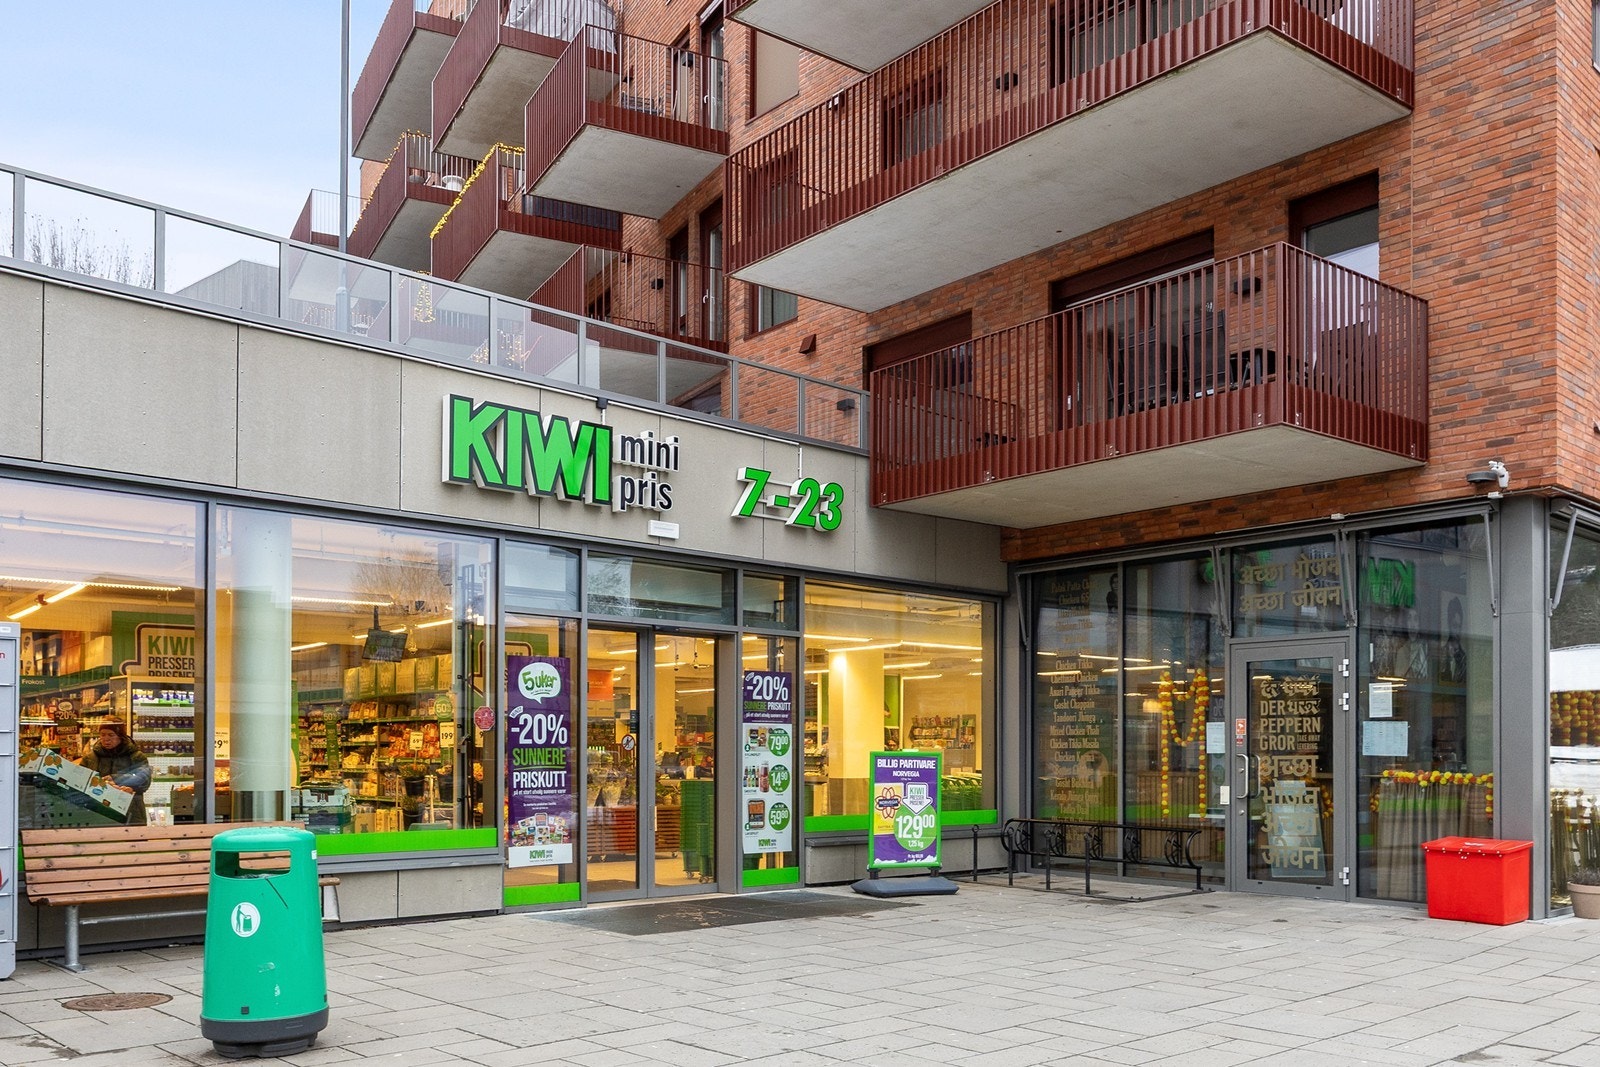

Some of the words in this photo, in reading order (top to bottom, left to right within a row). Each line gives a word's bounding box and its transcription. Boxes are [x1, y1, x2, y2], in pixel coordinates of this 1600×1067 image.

[445, 394, 613, 505] KIWI
[619, 430, 679, 472] mini
[619, 471, 673, 511] pris
[148, 635, 195, 655] KIWI
[149, 656, 195, 670] PRESSER
[746, 675, 788, 701] -20%
[1260, 700, 1285, 715] DER
[511, 713, 568, 745] -20%
[1260, 717, 1320, 733] PEPPERN
[1260, 734, 1295, 751] GROR
[512, 747, 567, 766] SUNNERE
[877, 759, 899, 768] BILLIG
[899, 760, 936, 769] PARTIVARE
[1259, 755, 1319, 777] अच्छा
[513, 771, 567, 788] PRISKUTT
[909, 787, 924, 795] KIWI
[1260, 778, 1320, 808] भोजन
[1258, 836, 1321, 870] जीवन
